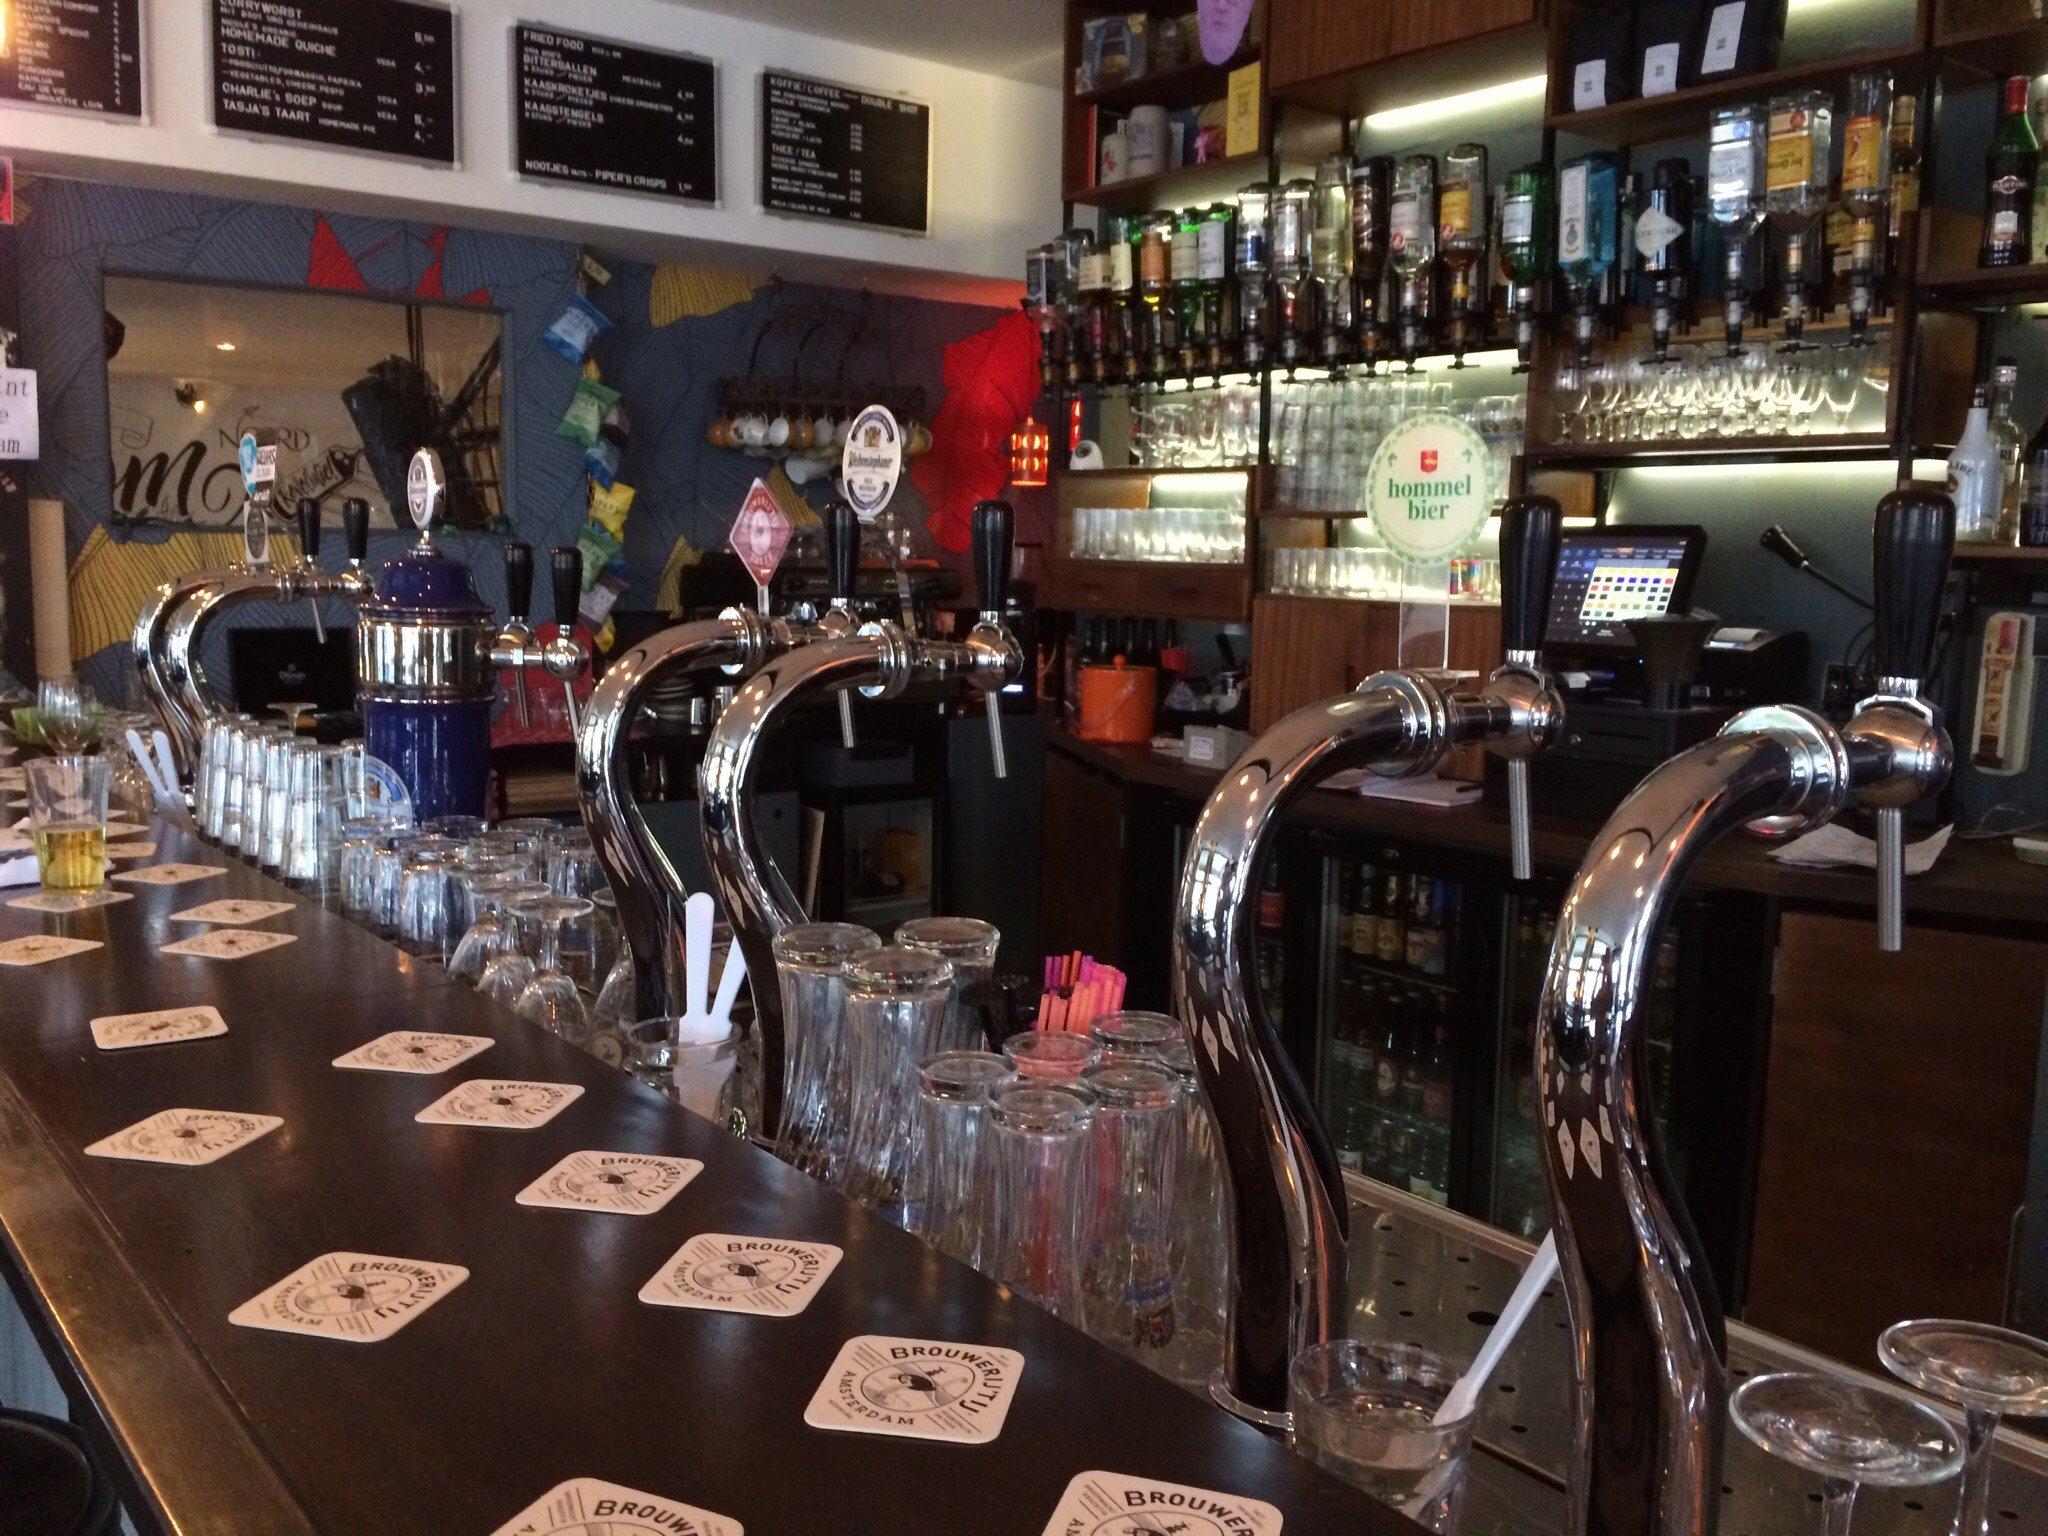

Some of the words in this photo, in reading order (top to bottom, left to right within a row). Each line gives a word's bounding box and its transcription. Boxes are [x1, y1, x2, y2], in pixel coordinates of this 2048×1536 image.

[1388, 475, 1471, 498] hommel
[1408, 500, 1446, 520] bier
[838, 1370, 915, 1426] AMSTERDAM
